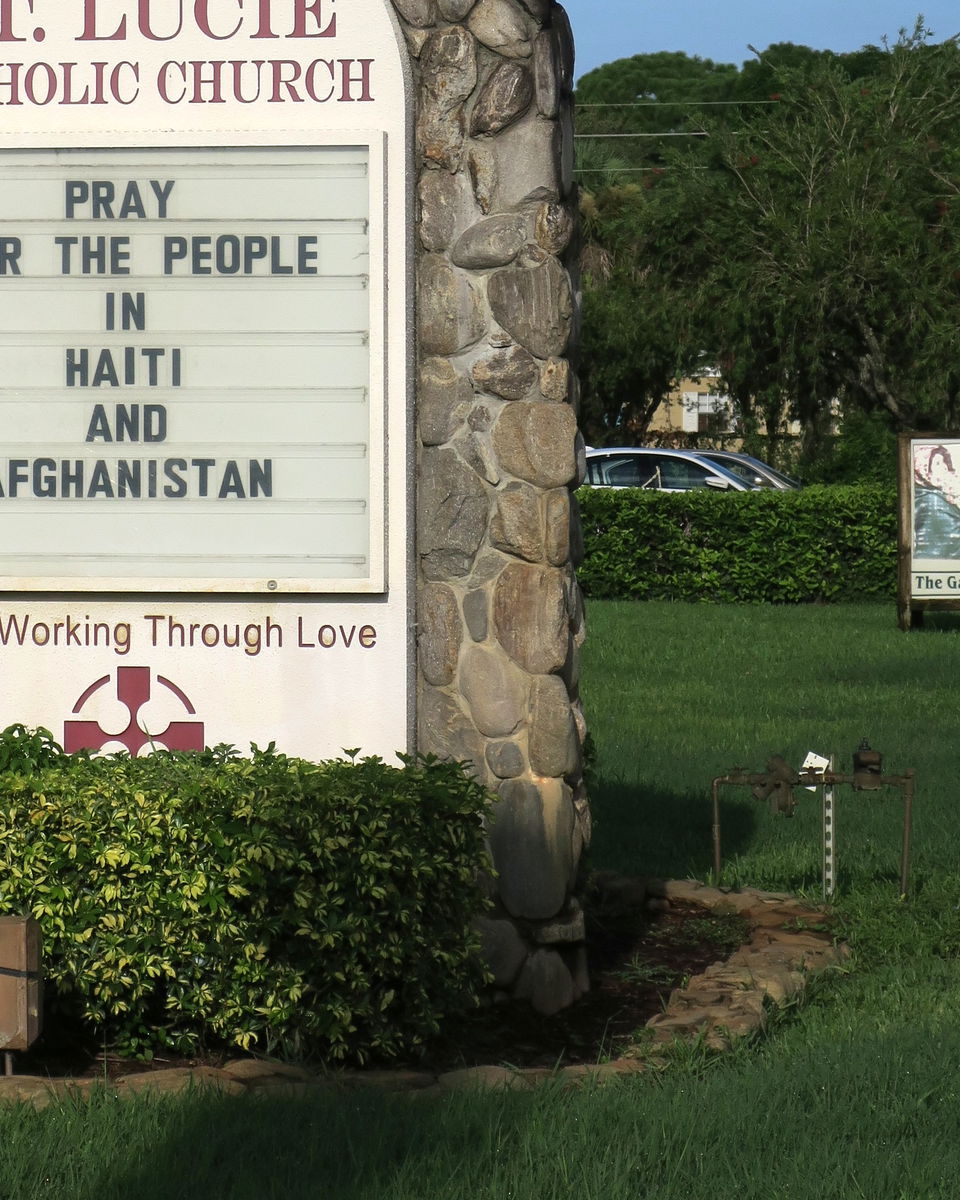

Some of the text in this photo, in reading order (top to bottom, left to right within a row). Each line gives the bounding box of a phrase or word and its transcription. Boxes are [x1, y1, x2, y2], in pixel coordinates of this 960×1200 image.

[157, 58, 375, 104] CHURCH
[65, 180, 176, 219] PRAY
[55, 235, 130, 275] THE
[163, 234, 318, 275] PEOPLE
[105, 292, 146, 331] IN
[65, 347, 181, 387] HAITI
[85, 403, 167, 443] AND
[915, 575, 960, 589] The G
[144, 615, 283, 656] Through
[297, 616, 377, 649] Love
